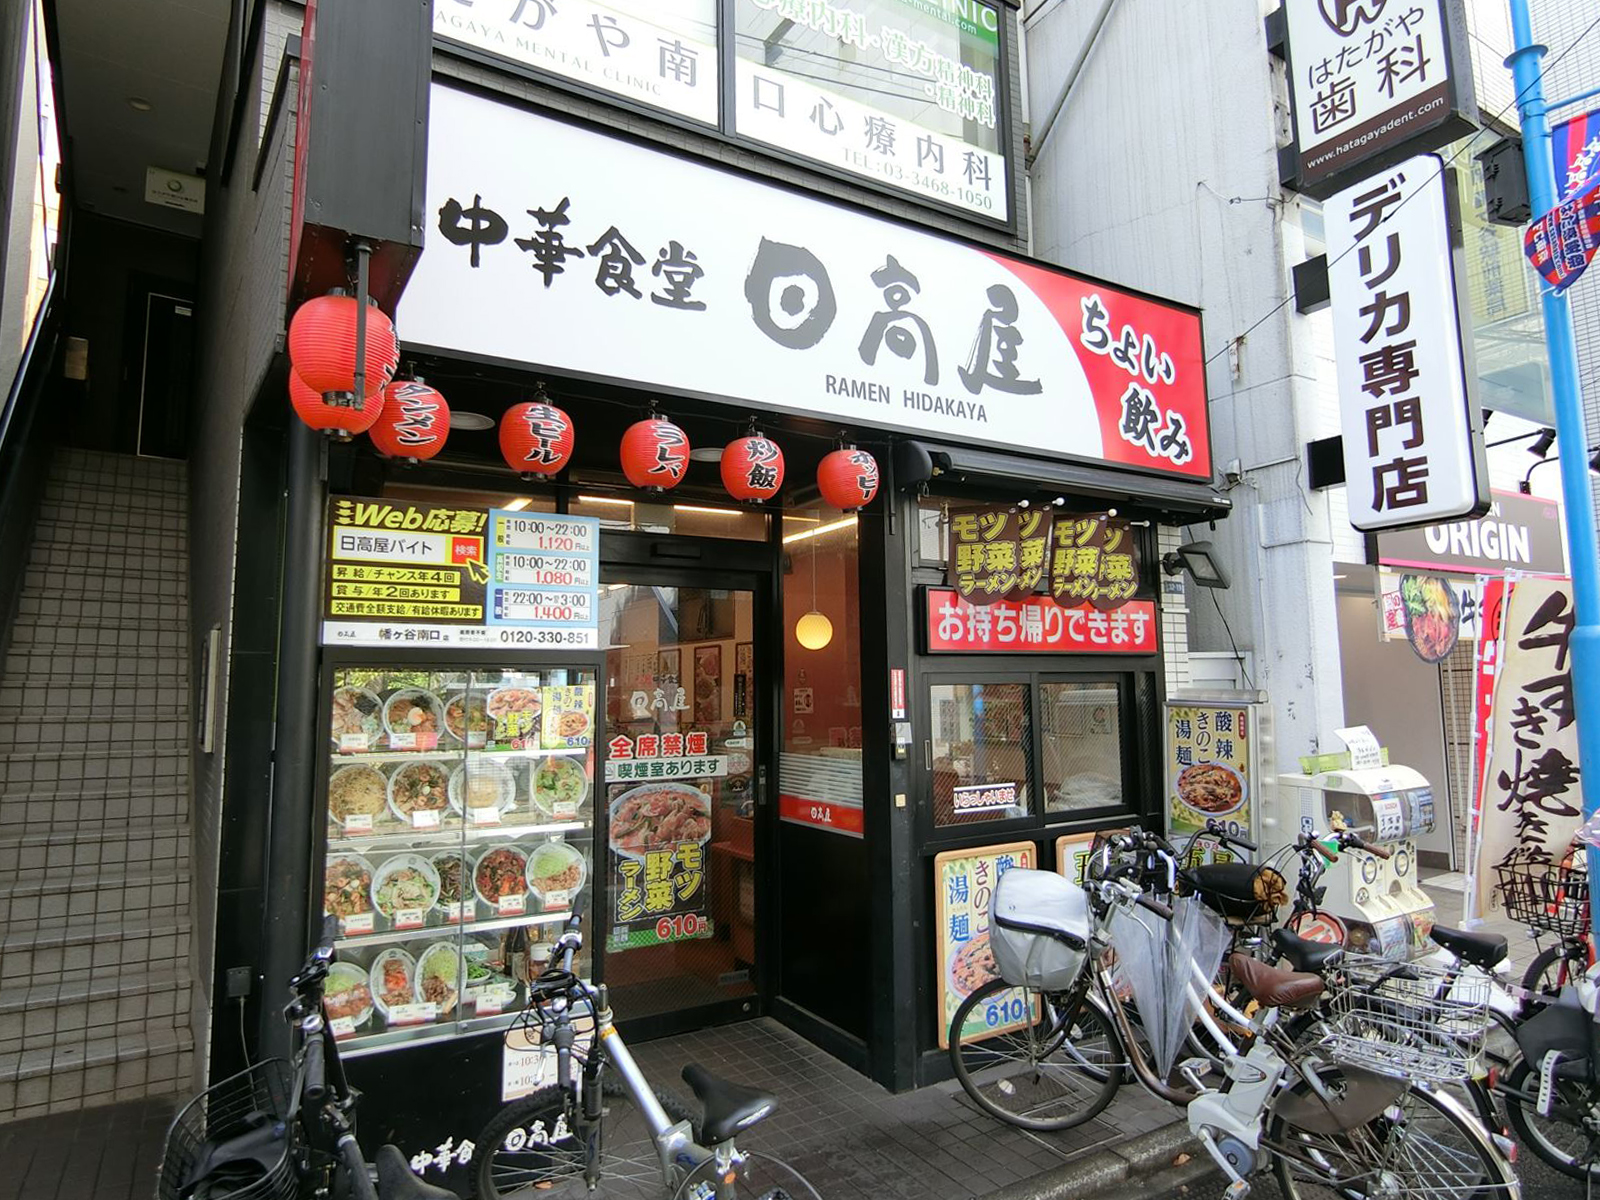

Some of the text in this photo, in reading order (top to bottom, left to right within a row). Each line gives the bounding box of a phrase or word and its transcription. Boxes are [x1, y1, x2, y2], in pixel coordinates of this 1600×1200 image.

[516, 37, 593, 73] MENTAL
[603, 68, 662, 97] CLINIC
[1308, 7, 1425, 90] はたがや
[455, 0, 991, 191] がや南 口心療内科
[1309, 34, 1431, 135] 歯科
[1306, 96, 1444, 169] www.hatagayadent.com
[438, 194, 707, 311] 中華食堂
[743, 235, 1043, 396] 日高屋
[1080, 294, 1175, 385] ちょい
[1350, 172, 1430, 513] デリカ専門店
[825, 374, 988, 423] RAMEN HIDAKAYA
[524, 404, 568, 465] 生ビール
[1119, 384, 1193, 466] 飲み
[746, 439, 779, 489] 炒飯
[355, 503, 488, 534] Web応募!
[952, 512, 1009, 542] モツ
[1054, 519, 1099, 548] モツ
[1424, 519, 1530, 563] ORIGIN
[341, 535, 432, 556] 日高屋バイト
[956, 541, 1016, 573] 野菜
[1020, 537, 1047, 569] 菜
[1052, 546, 1100, 577] 野菜
[1100, 555, 1133, 582] 菜
[958, 573, 1016, 596] ラーメン
[938, 602, 1149, 645] お持ち帰りできます
[630, 687, 690, 713] 日高屋
[610, 732, 707, 760] 全席禁煙
[1196, 711, 1212, 764] きのこ
[1215, 711, 1233, 760] 酸辣
[617, 759, 720, 779] 喫煙室あります
[953, 787, 1016, 808] いらっしゃいませ
[618, 860, 643, 922] ラーメン
[644, 850, 675, 912] 野菜
[675, 842, 703, 901] モツ
[973, 860, 991, 933] きのこ
[949, 875, 970, 943] 湯麺
